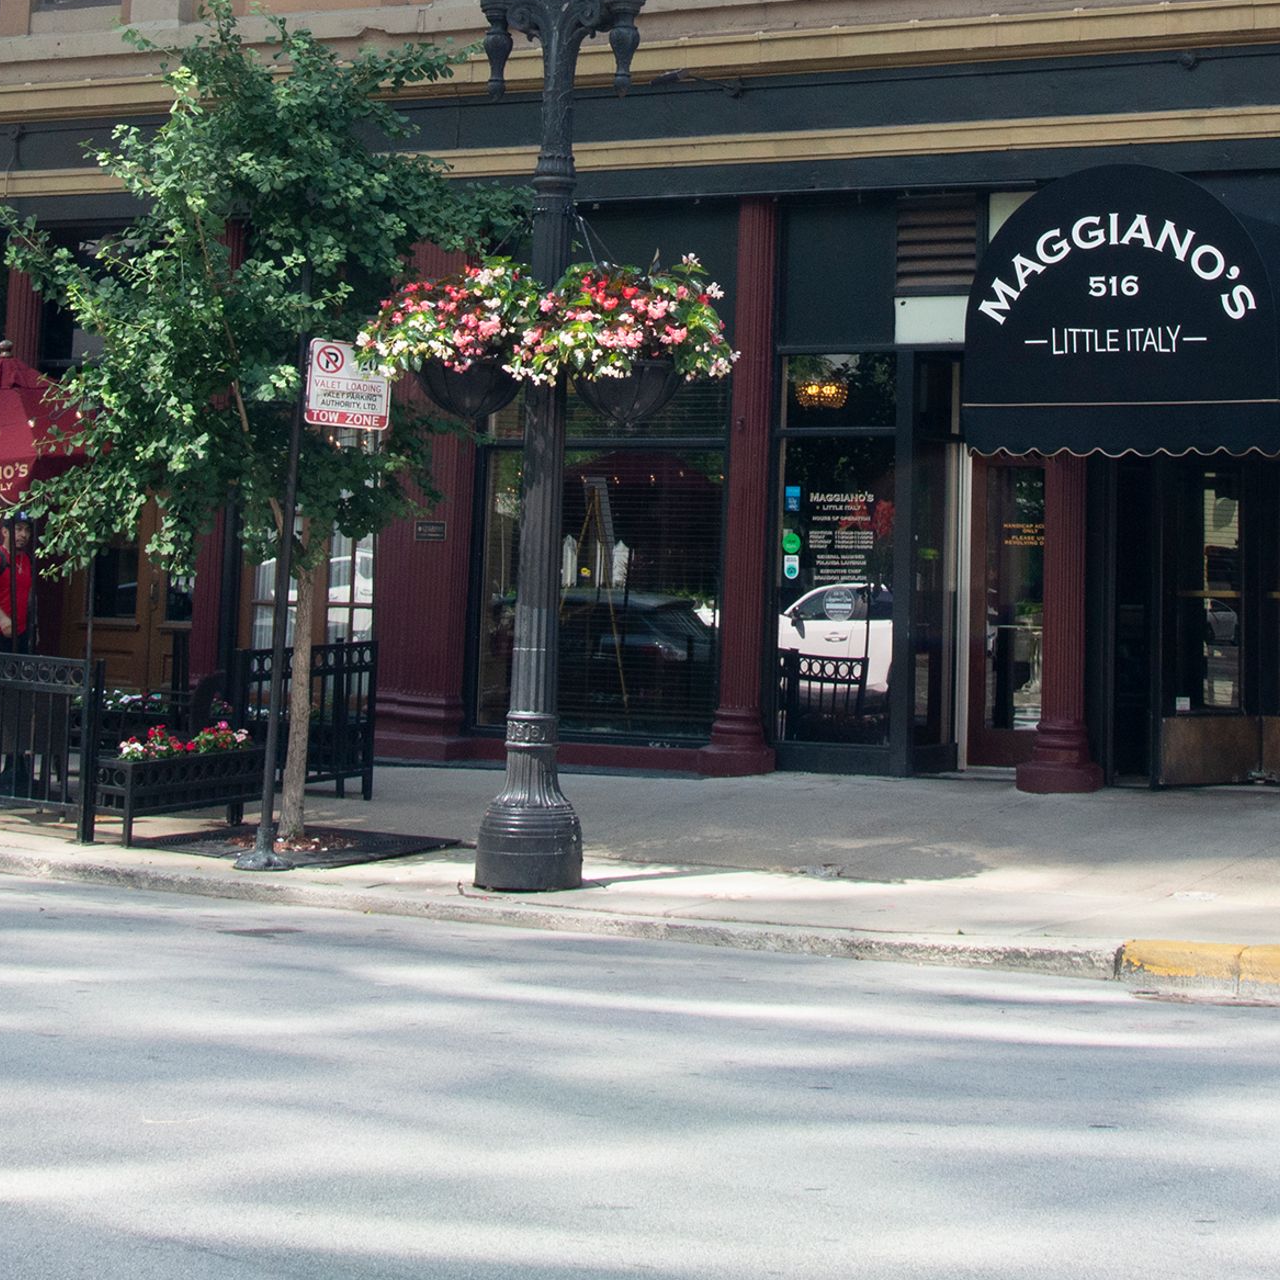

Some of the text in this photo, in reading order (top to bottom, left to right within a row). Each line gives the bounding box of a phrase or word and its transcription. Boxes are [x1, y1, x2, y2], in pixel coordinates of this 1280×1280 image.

[978, 213, 1257, 325] MAGGIANO'S
[1088, 275, 1139, 297] 516
[1052, 325, 1180, 355] LITTLE ITALY
[314, 379, 382, 393] VALET LOADING
[323, 391, 377, 402] VALET PARKING
[311, 410, 380, 426] TOW ZONE
[809, 491, 875, 503] MAGGIANO'S
